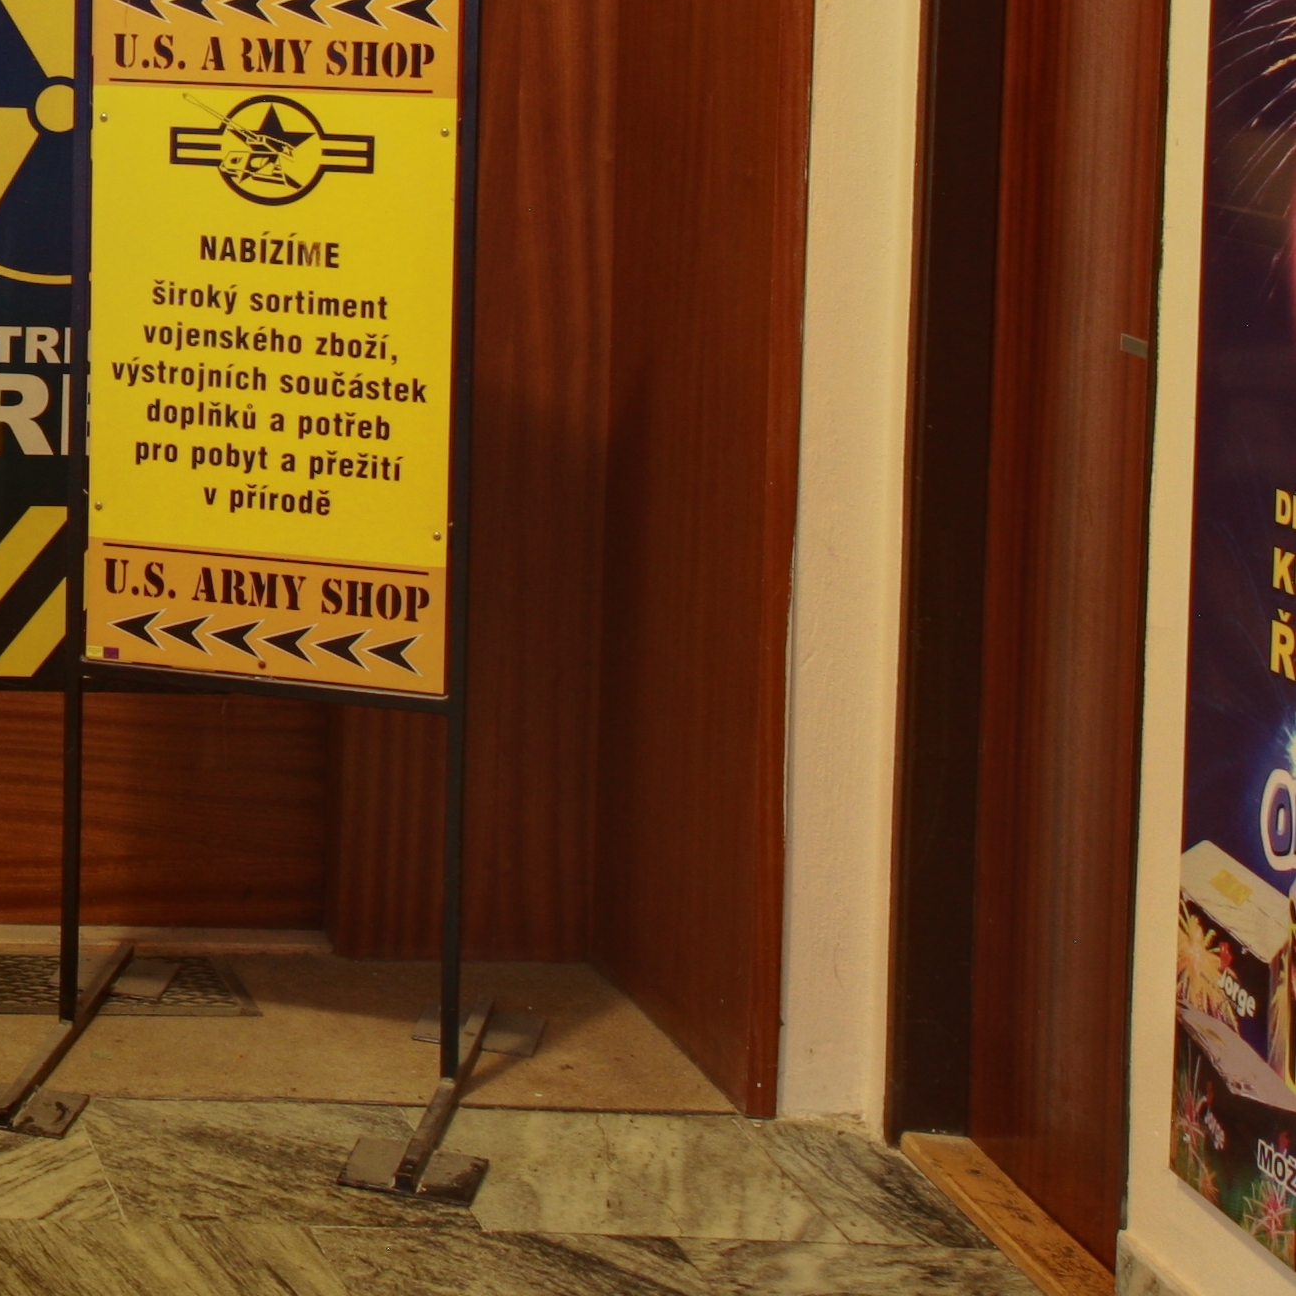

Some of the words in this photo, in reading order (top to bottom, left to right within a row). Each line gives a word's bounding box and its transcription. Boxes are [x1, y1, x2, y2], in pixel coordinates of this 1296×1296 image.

[113, 33, 186, 70] U.S.
[325, 40, 435, 78] SHOP
[199, 231, 340, 269] NABÍZÍME
[152, 279, 237, 315] široký
[249, 290, 388, 320] sortiment
[143, 322, 302, 354] vojenského
[315, 331, 398, 365] zboží,
[111, 357, 267, 392] výstrojních
[280, 371, 427, 403] součástek
[146, 399, 256, 430] doplňků
[269, 412, 285, 432] a
[298, 411, 391, 441] potřeb
[135, 440, 178, 465] pro
[190, 443, 268, 474] pobyt
[280, 453, 295, 473] a
[309, 450, 404, 482] přežití
[203, 486, 216, 505] v
[229, 484, 331, 516] přírodě
[104, 557, 176, 599] U.S.
[192, 567, 306, 611] ARMY
[321, 578, 430, 622] SHOP
[1217, 967, 1256, 1018] Jorge
